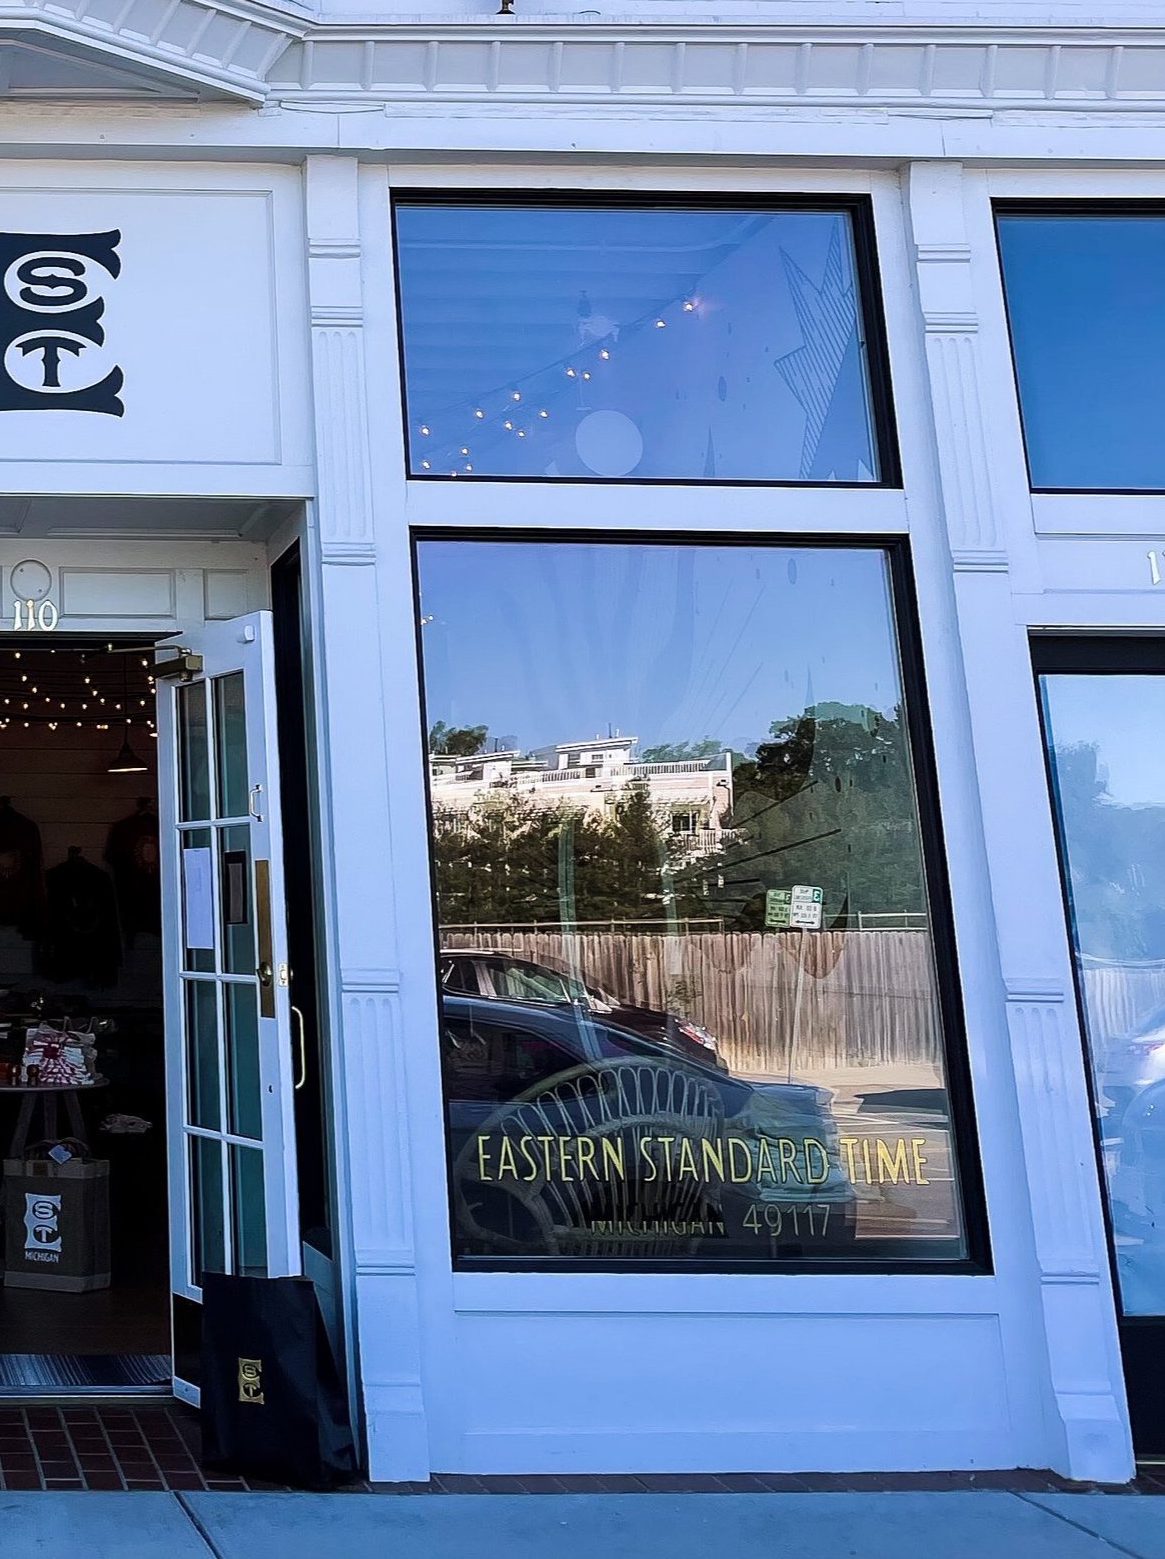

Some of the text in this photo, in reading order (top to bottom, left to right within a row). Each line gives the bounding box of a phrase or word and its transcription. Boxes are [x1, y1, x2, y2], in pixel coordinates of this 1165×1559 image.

[13, 599, 58, 632] 110
[477, 1134, 930, 1186] EASTERN STANDARD TIME
[741, 1203, 832, 1237] 49117
[25, 1251, 59, 1263] MICHIGAN
